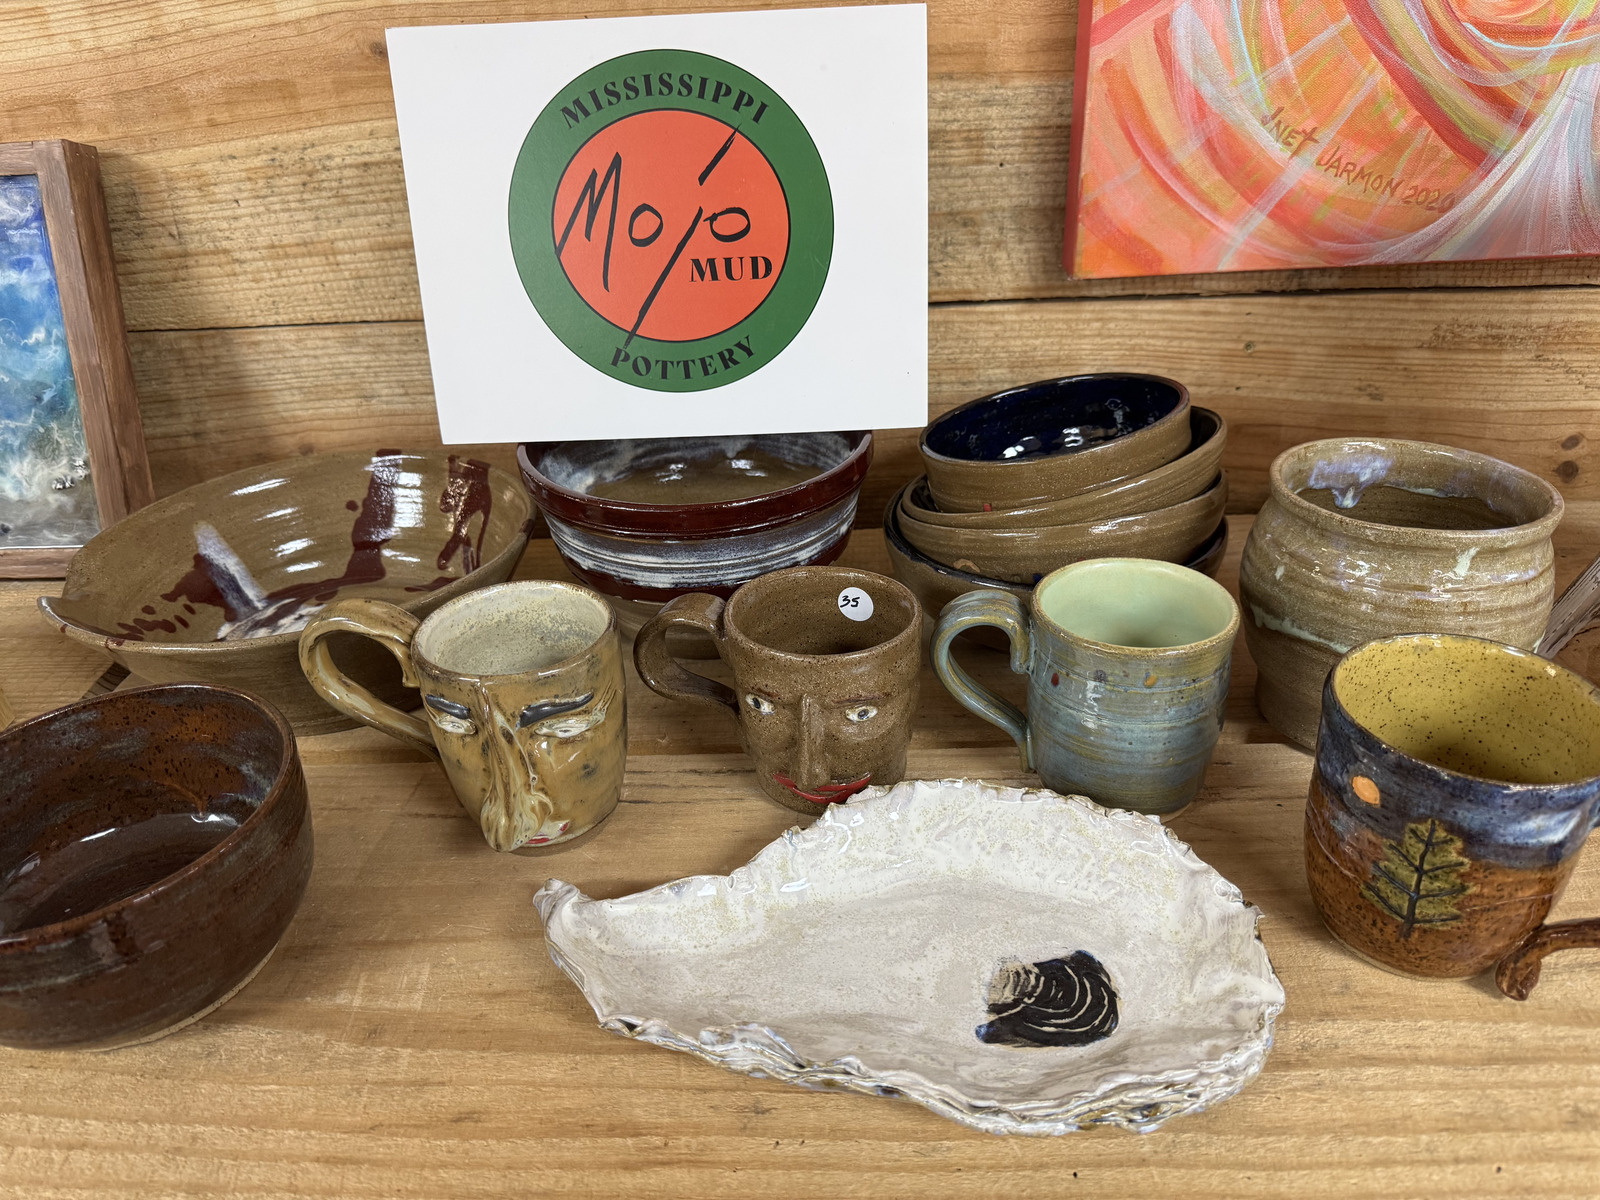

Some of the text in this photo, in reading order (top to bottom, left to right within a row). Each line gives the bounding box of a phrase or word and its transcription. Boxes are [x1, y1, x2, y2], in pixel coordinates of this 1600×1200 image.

[559, 72, 769, 129] MISSISSIPPI
[1315, 145, 1404, 198] JARMON
[554, 122, 751, 349] Mojo
[689, 256, 773, 282] MUD
[610, 335, 757, 380] POTTERY
[840, 595, 860, 608] 35
